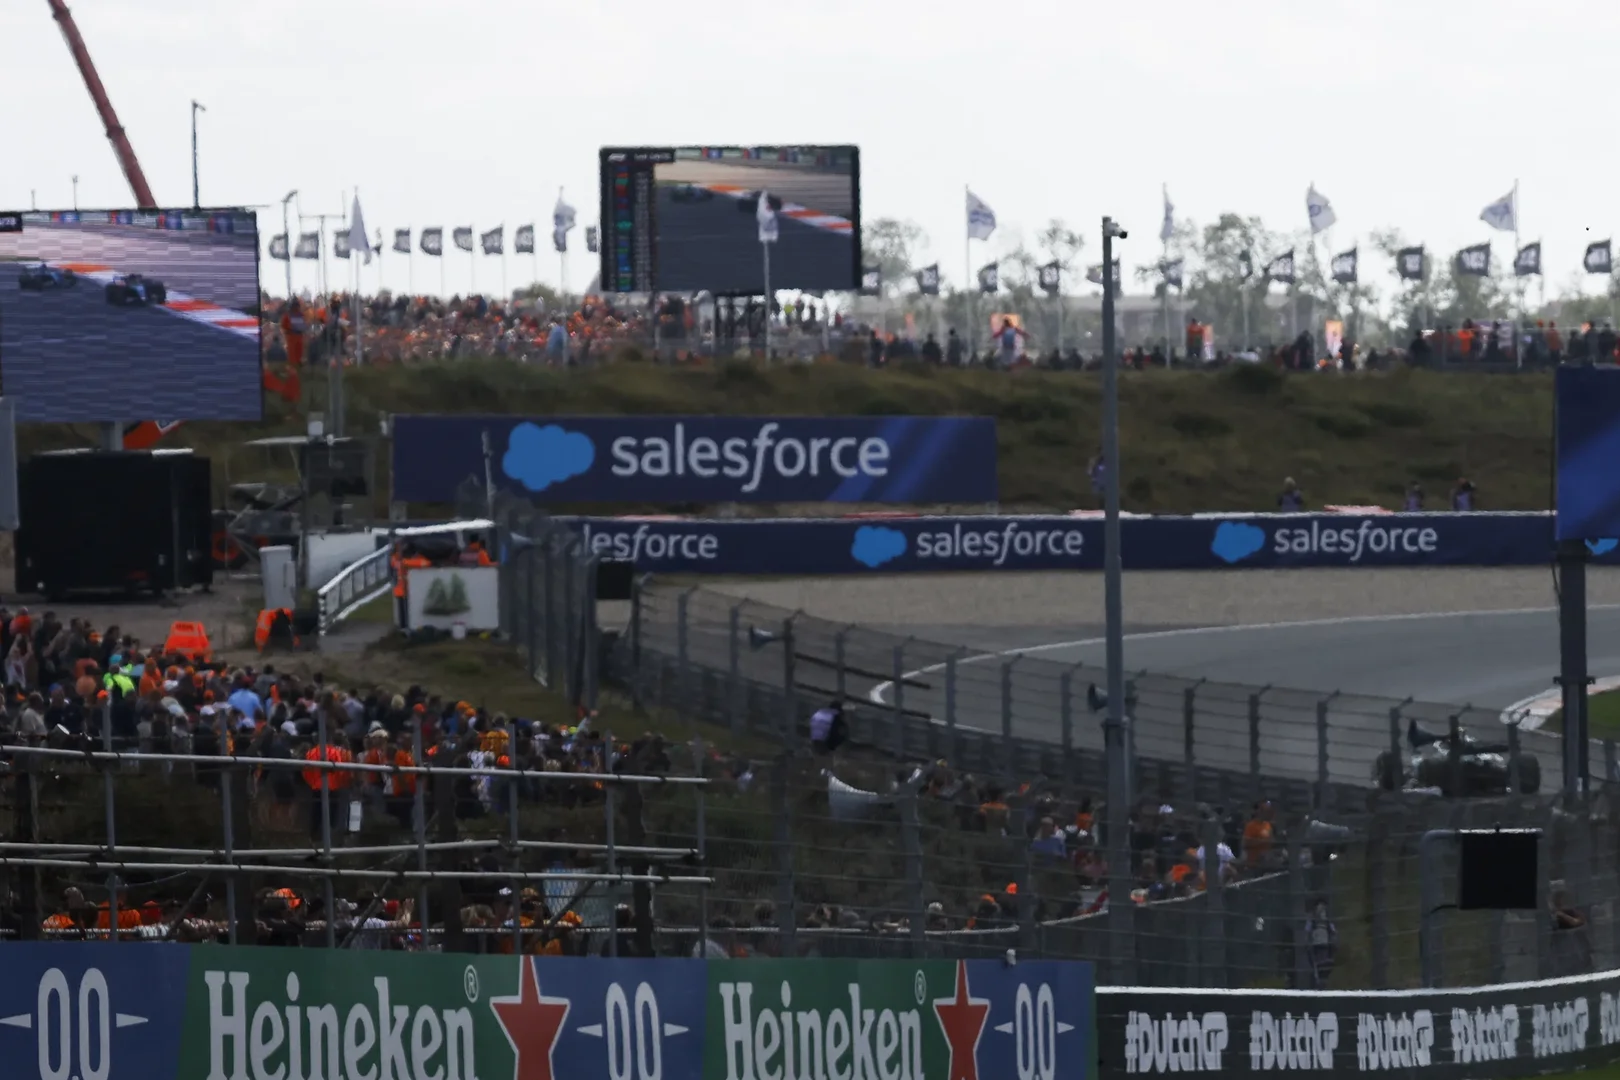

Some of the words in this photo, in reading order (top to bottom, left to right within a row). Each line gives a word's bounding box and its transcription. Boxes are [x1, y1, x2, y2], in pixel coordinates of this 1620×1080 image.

[610, 422, 891, 493] salesforce
[916, 522, 1084, 562] salesforce
[1273, 520, 1438, 562] salesforce
